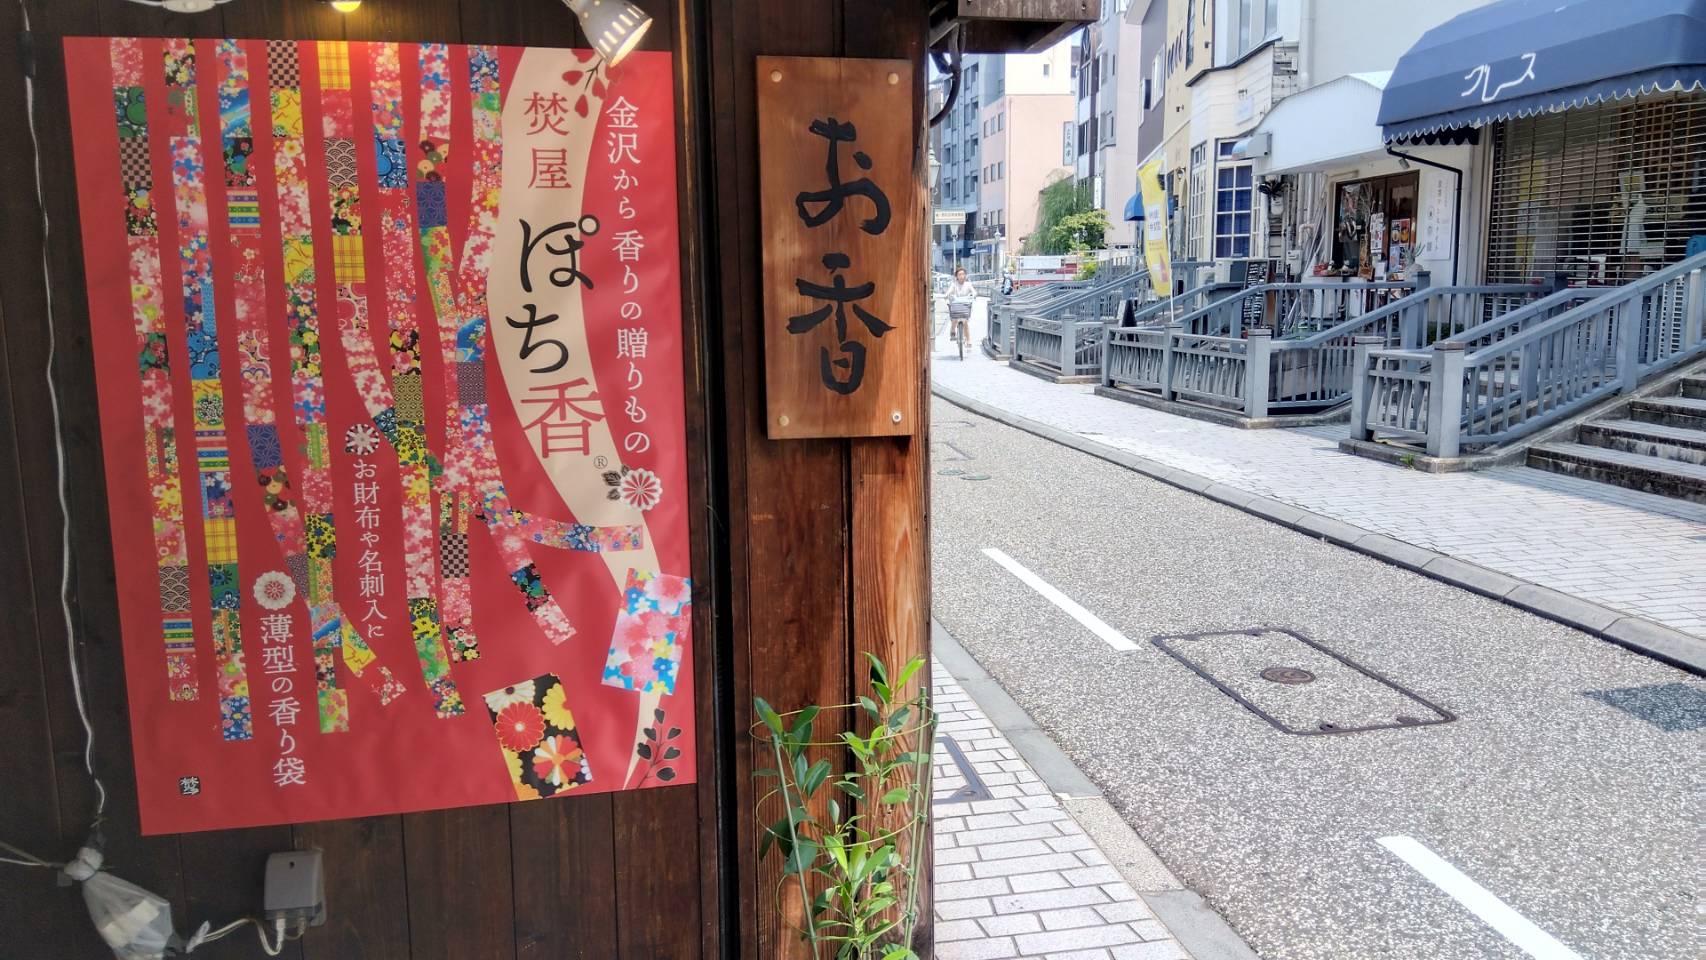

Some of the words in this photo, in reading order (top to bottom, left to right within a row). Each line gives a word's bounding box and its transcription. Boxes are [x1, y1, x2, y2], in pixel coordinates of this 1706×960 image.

[523, 91, 572, 190] 焚屋
[505, 214, 606, 459] ぽち香
[605, 95, 650, 454] 金沢から香りの贈りもの
[786, 117, 897, 395] お香
[353, 459, 388, 638] お財布や名刺入に
[260, 614, 307, 787] 薄型の香り袋
